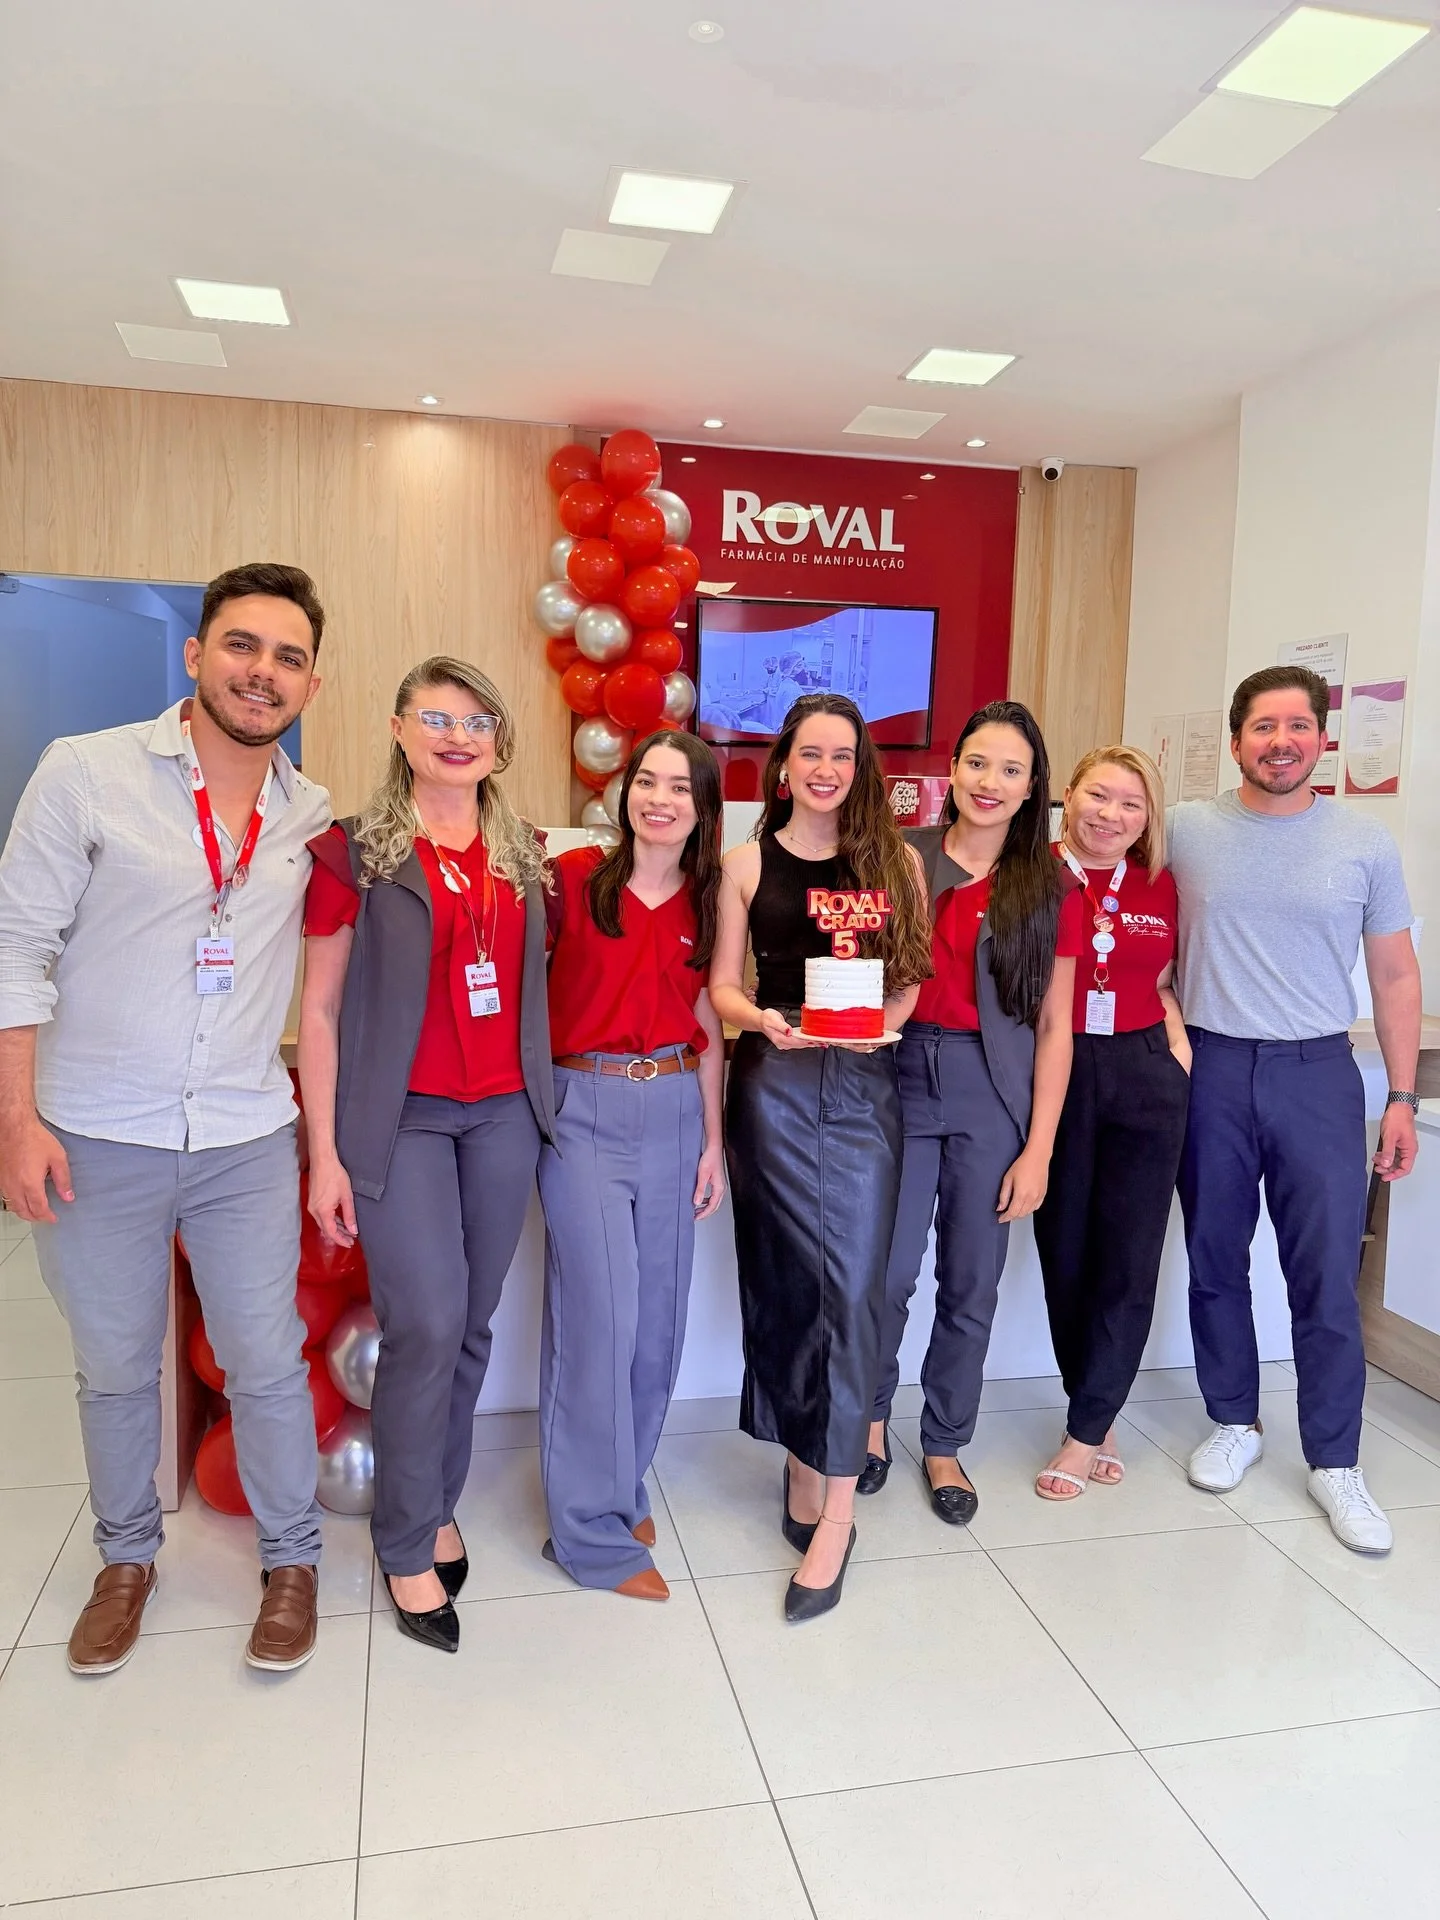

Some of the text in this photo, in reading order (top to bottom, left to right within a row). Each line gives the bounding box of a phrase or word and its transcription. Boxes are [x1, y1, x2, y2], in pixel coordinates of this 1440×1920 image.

[721, 489, 905, 552] ROVAL
[720, 548, 905, 570] FARMÁCIA DE MANIPULAÇÃO
[896, 788, 918, 797] CON
[894, 806, 917, 815] DOR
[810, 891, 891, 915] ROVAL
[819, 913, 882, 930] CRATO
[203, 947, 230, 955] ROVAL
[834, 930, 856, 958] 5
[471, 972, 492, 980] ROVAL
